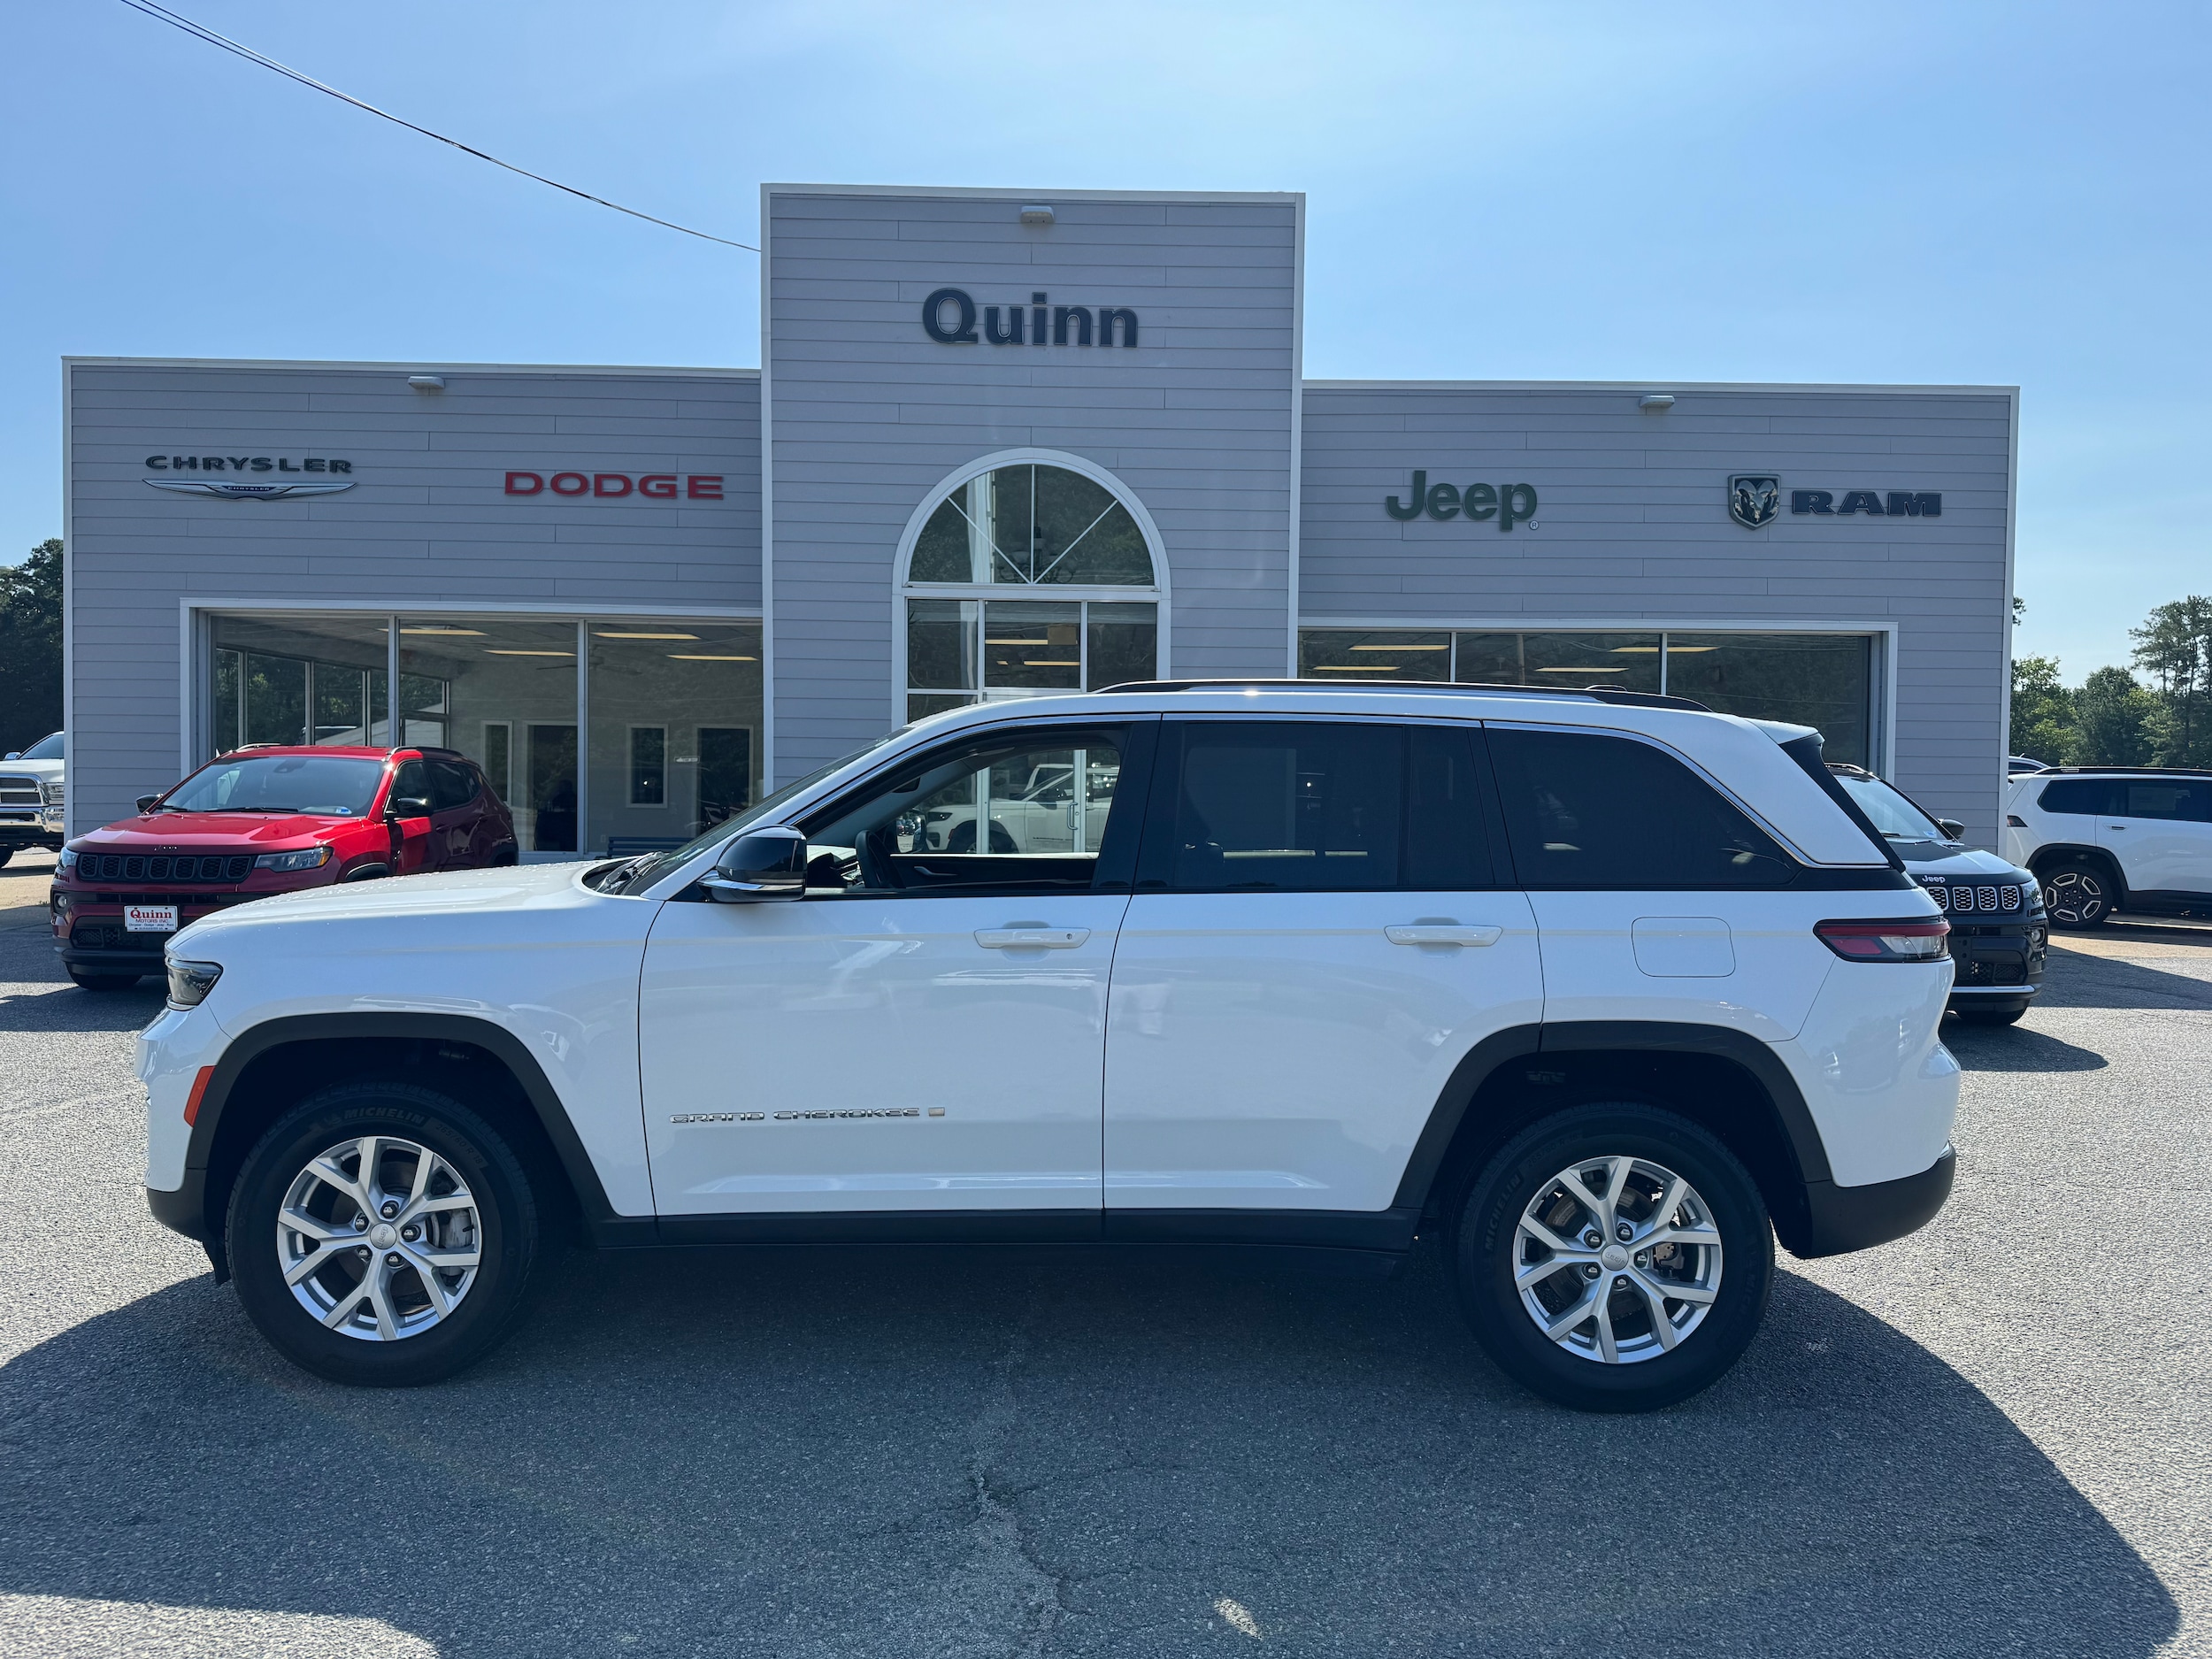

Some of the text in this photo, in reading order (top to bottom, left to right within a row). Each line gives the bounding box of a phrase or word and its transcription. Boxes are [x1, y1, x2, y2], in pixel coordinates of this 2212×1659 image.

[923, 288, 1138, 348] Quinn
[145, 455, 351, 473] CHRYSLER
[504, 472, 724, 500] DODGE
[1386, 470, 1538, 531] Jeep
[1792, 490, 1942, 517] RAM
[1922, 874, 1946, 883] Jeep
[130, 910, 173, 919] Quinn
[343, 1107, 426, 1125] MICHELIN
[669, 1107, 920, 1124] GRAND CHEROKEE
[1484, 1172, 1521, 1253] MICHELIN
